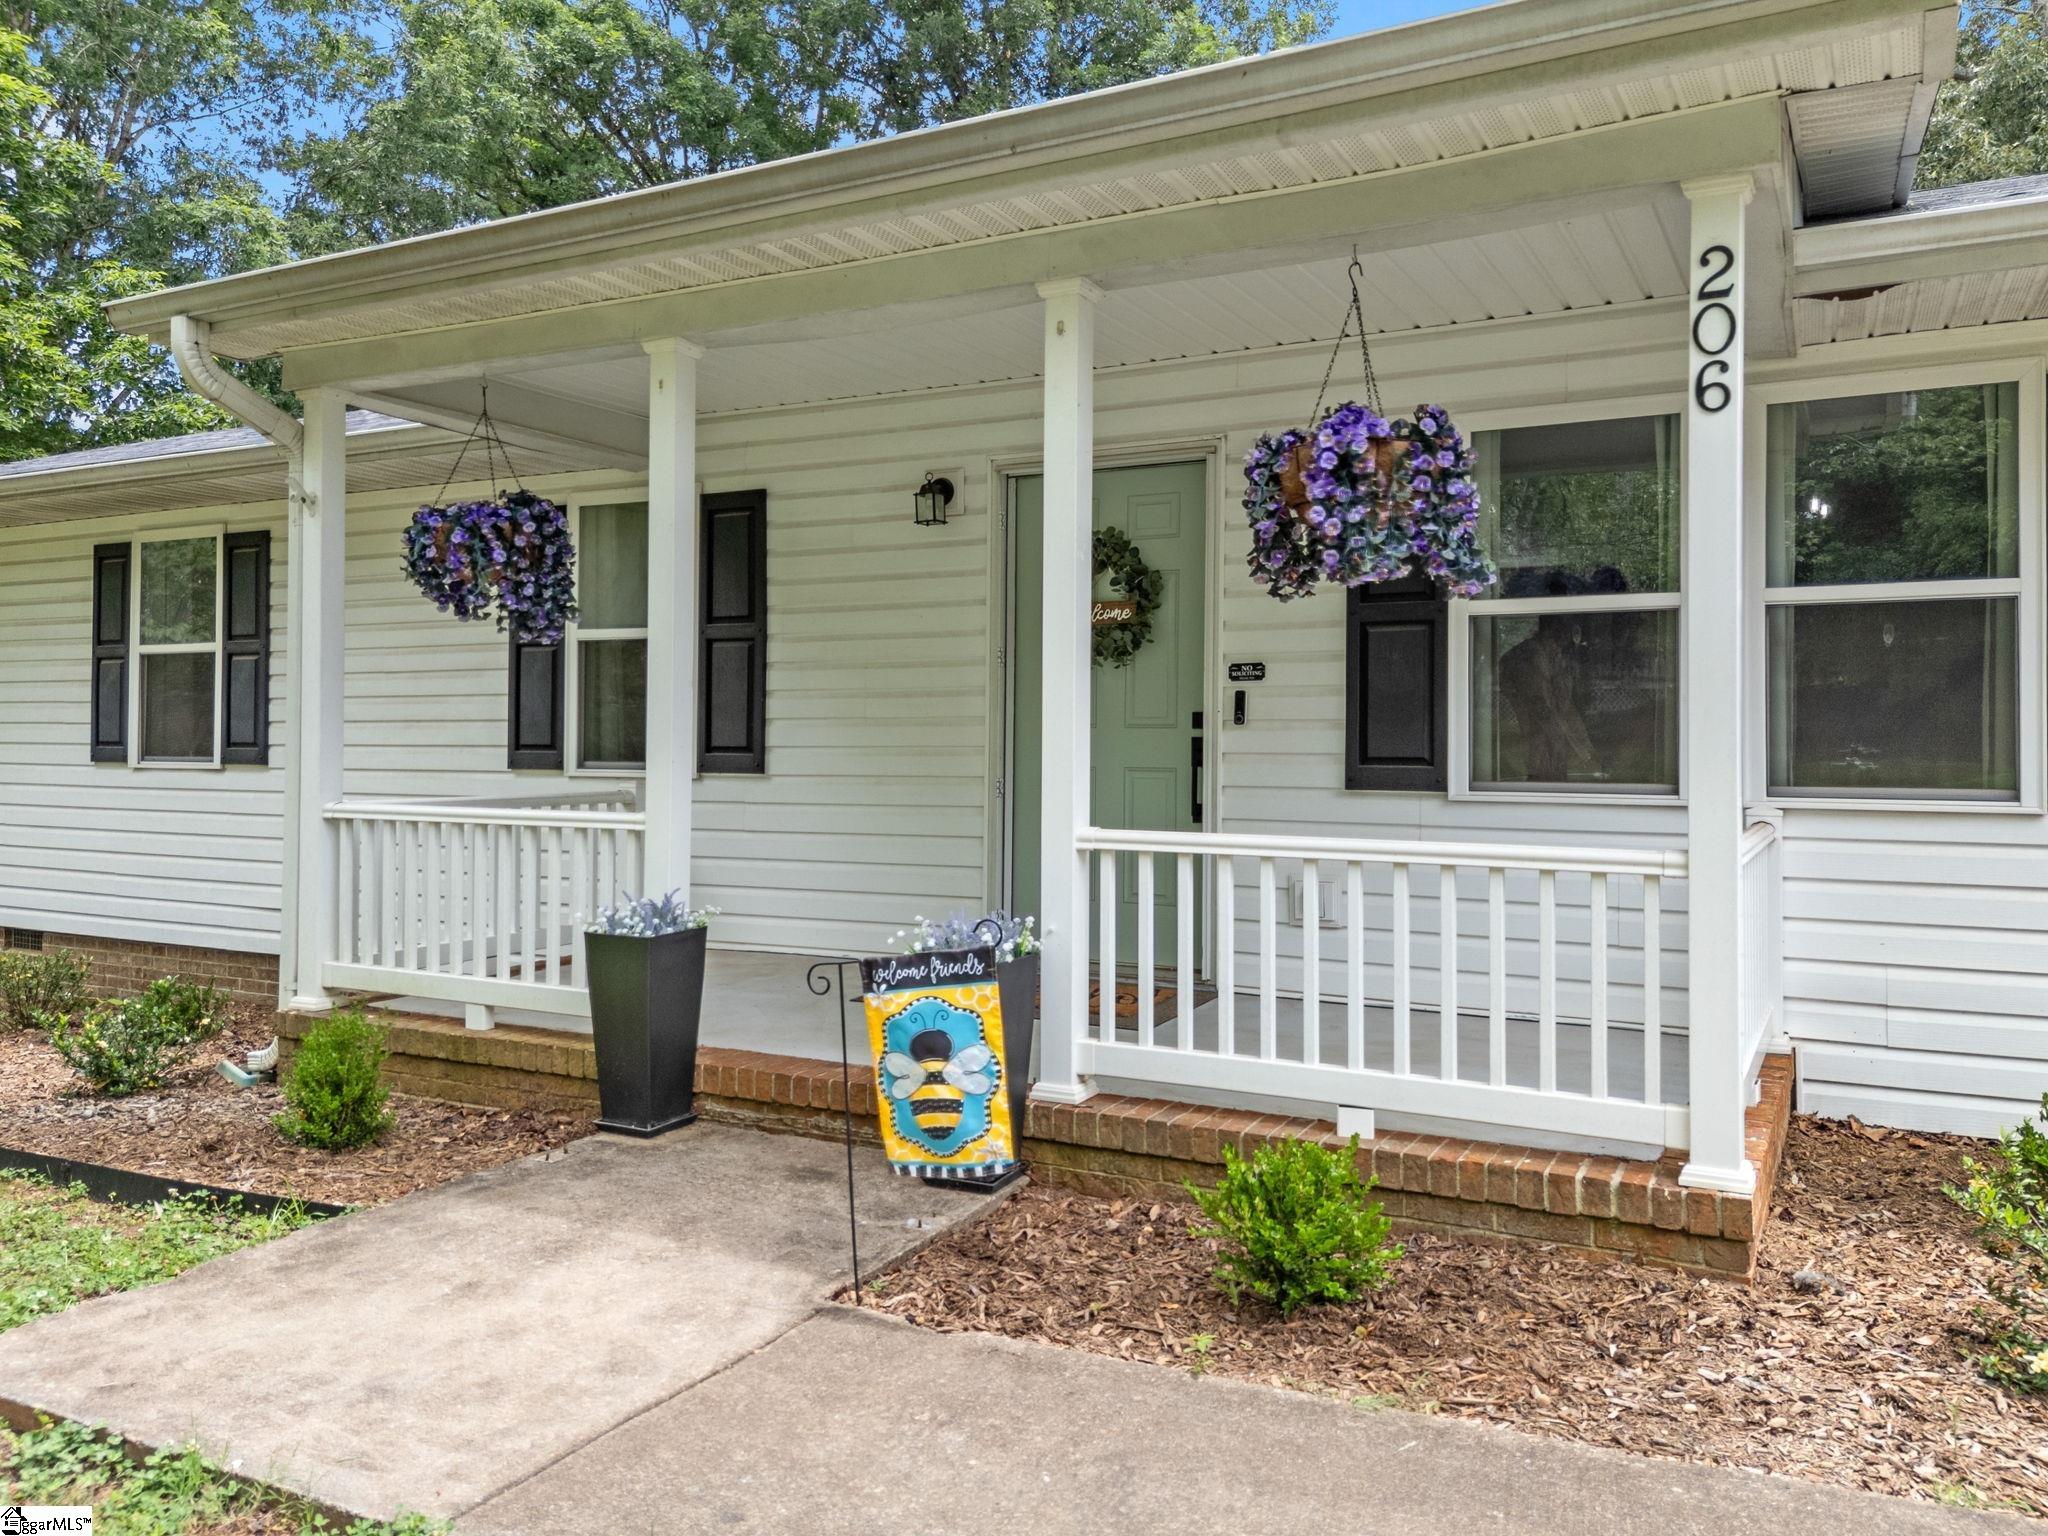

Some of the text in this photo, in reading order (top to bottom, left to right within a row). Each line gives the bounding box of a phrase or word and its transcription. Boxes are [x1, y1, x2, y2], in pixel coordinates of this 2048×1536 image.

[1692, 245, 1736, 413] 206
[1091, 603, 1132, 622] lcome
[872, 953, 985, 985] welcome friends
